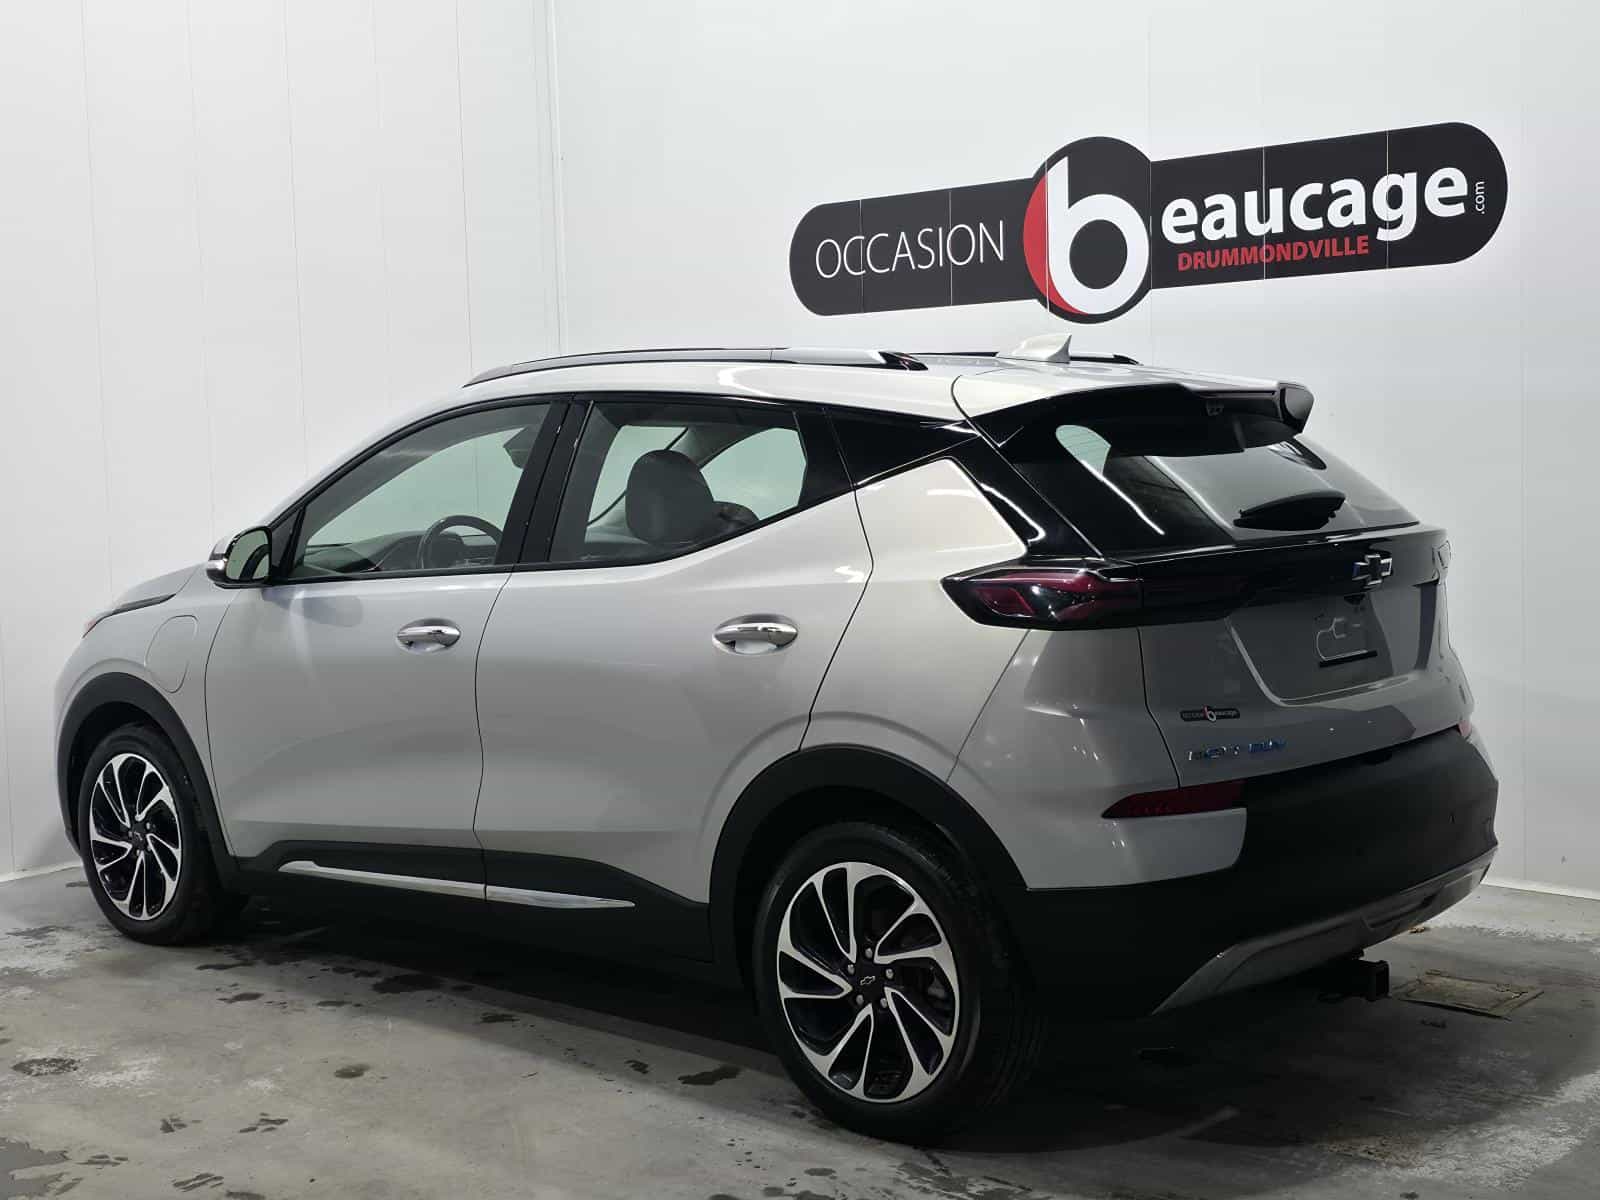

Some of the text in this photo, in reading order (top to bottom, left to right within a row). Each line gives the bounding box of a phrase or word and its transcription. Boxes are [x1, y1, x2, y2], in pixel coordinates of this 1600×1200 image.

[1474, 181, 1486, 215] .com
[815, 155, 1468, 316] OCCASION beaucage
[1177, 235, 1369, 272] DRUMMONDVILLE
